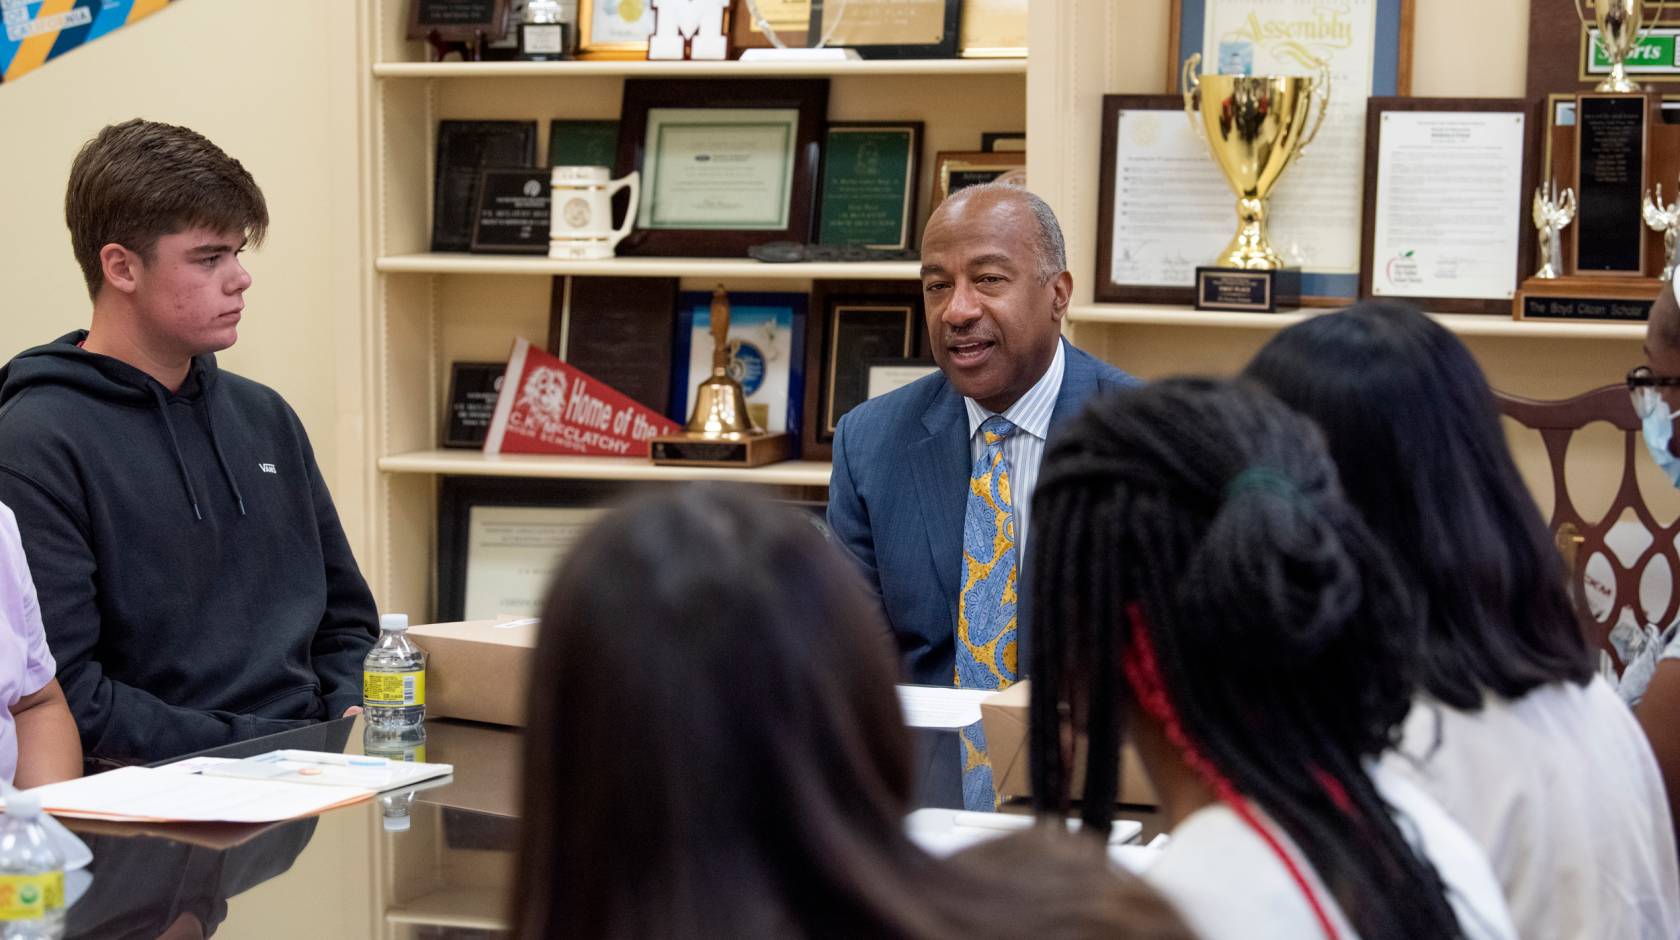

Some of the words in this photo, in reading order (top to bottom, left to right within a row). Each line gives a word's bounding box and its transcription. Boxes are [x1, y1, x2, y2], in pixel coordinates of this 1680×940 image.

[1221, 9, 1353, 48] Assembly
[1529, 301, 1546, 313] The
[565, 377, 612, 430] Home
[613, 408, 634, 436] of
[633, 414, 658, 441] the
